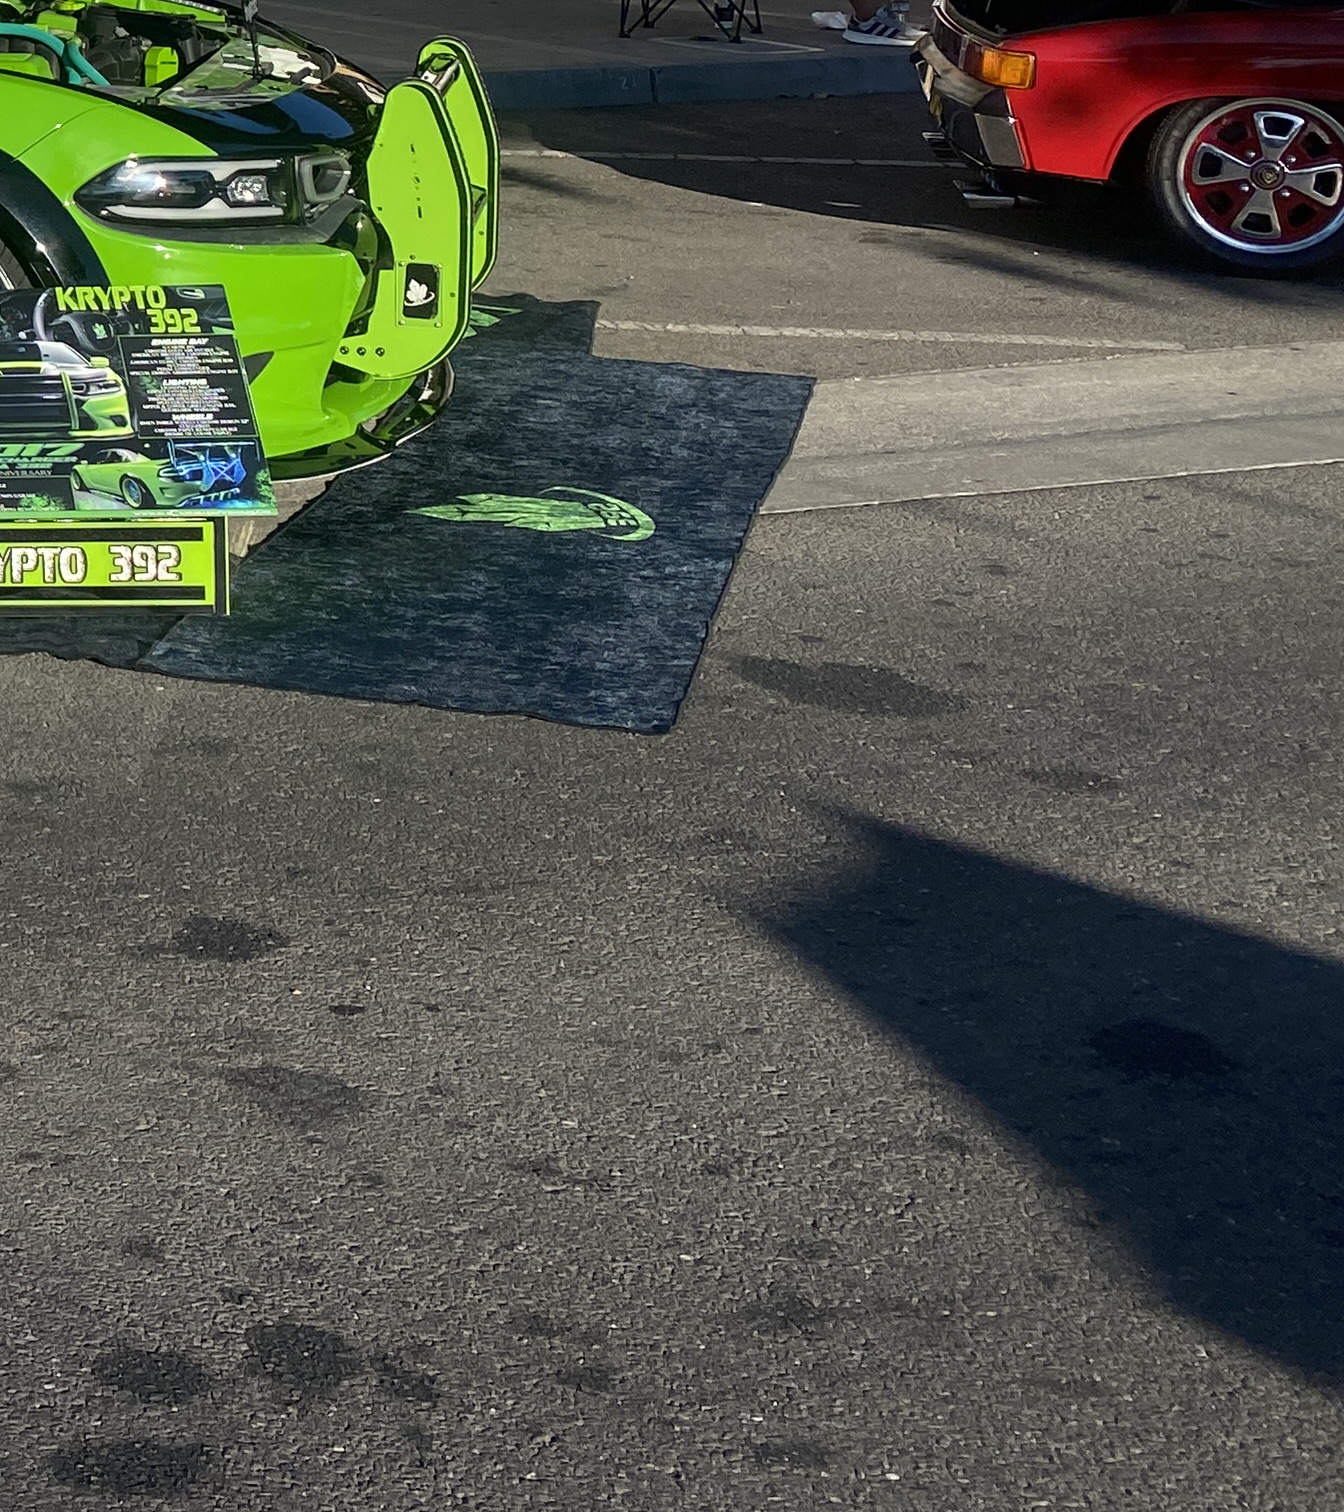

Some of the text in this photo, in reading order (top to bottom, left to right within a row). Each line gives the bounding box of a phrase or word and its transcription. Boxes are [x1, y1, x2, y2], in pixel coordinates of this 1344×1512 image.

[55, 285, 167, 312] KRYPTO
[146, 308, 201, 334] 392
[109, 544, 183, 583] 392
